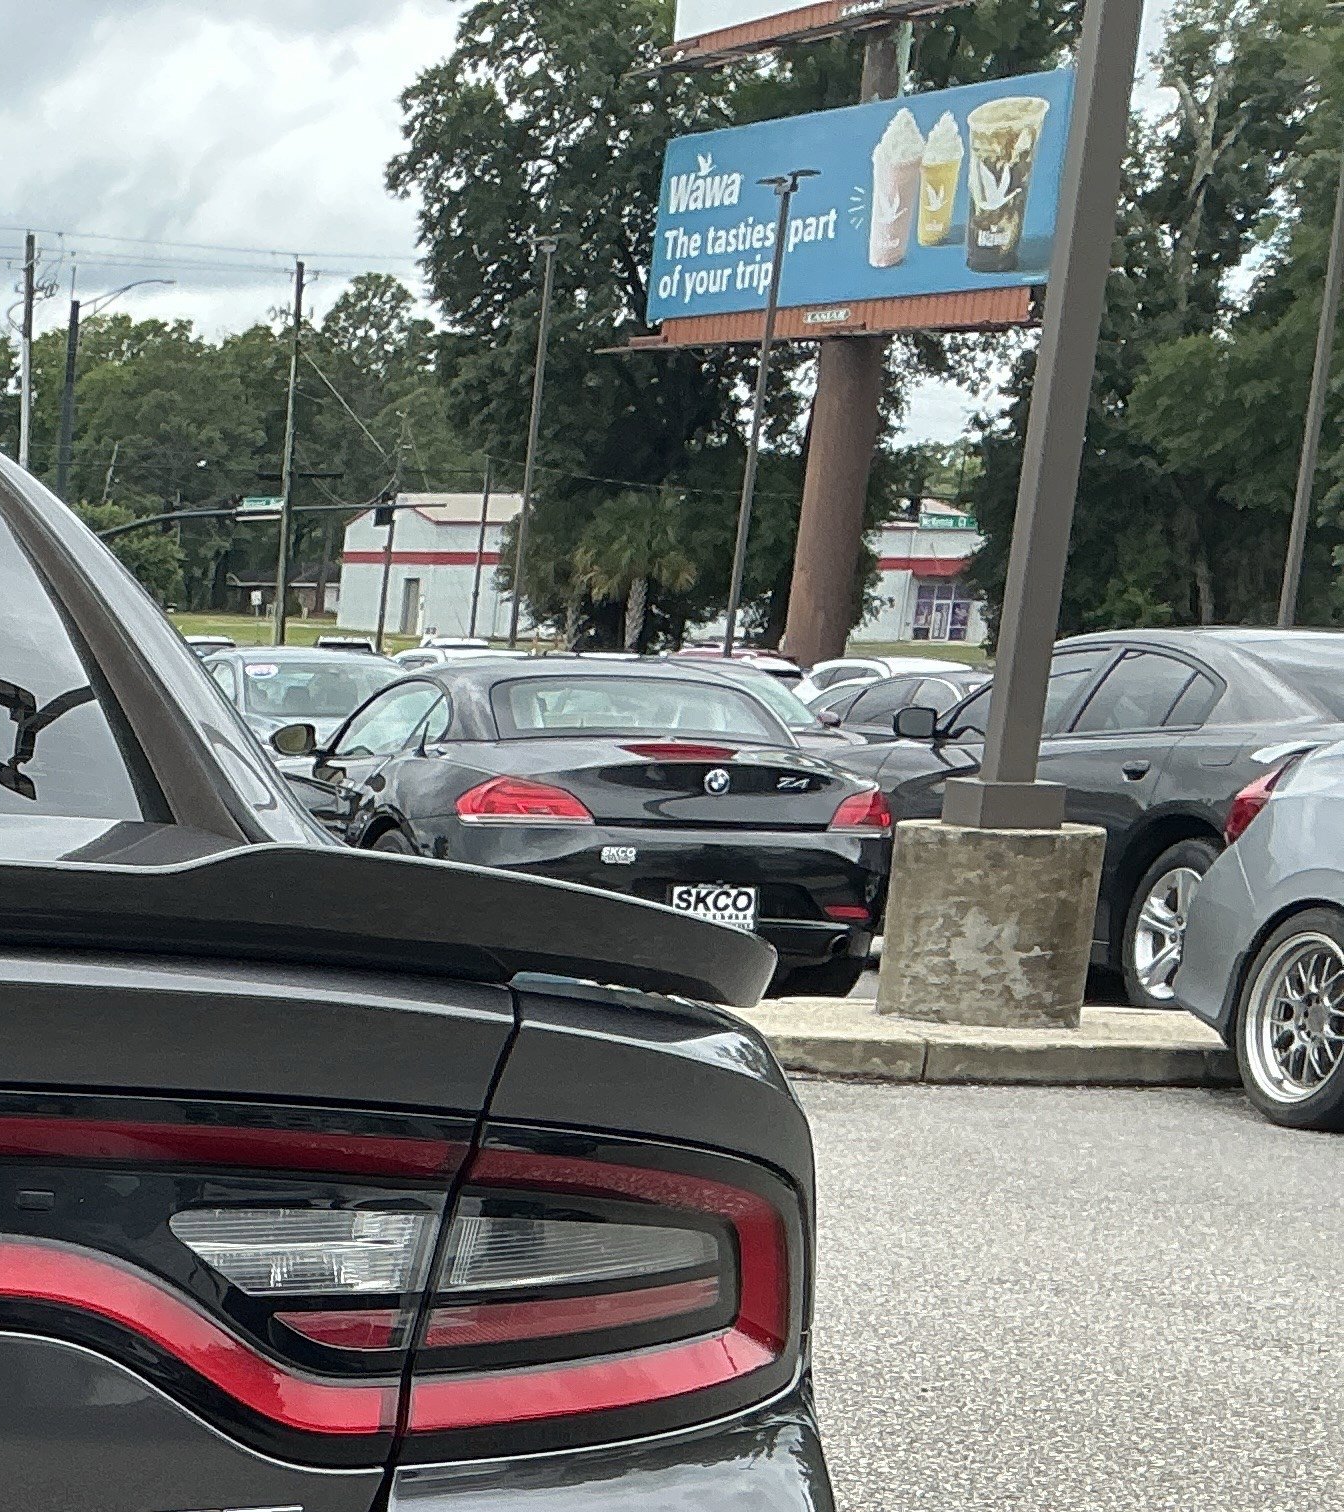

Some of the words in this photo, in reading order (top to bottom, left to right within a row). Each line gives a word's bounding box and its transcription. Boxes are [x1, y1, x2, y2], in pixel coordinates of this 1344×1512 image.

[669, 171, 742, 214] Wawa
[664, 227, 702, 260] The
[707, 216, 777, 256] tasties
[787, 208, 838, 252] part
[658, 264, 682, 299] of
[684, 267, 733, 304] your
[735, 254, 774, 295] trip
[776, 777, 810, 790] Z4
[601, 846, 636, 858] SKCO
[674, 889, 752, 912] SKCO
